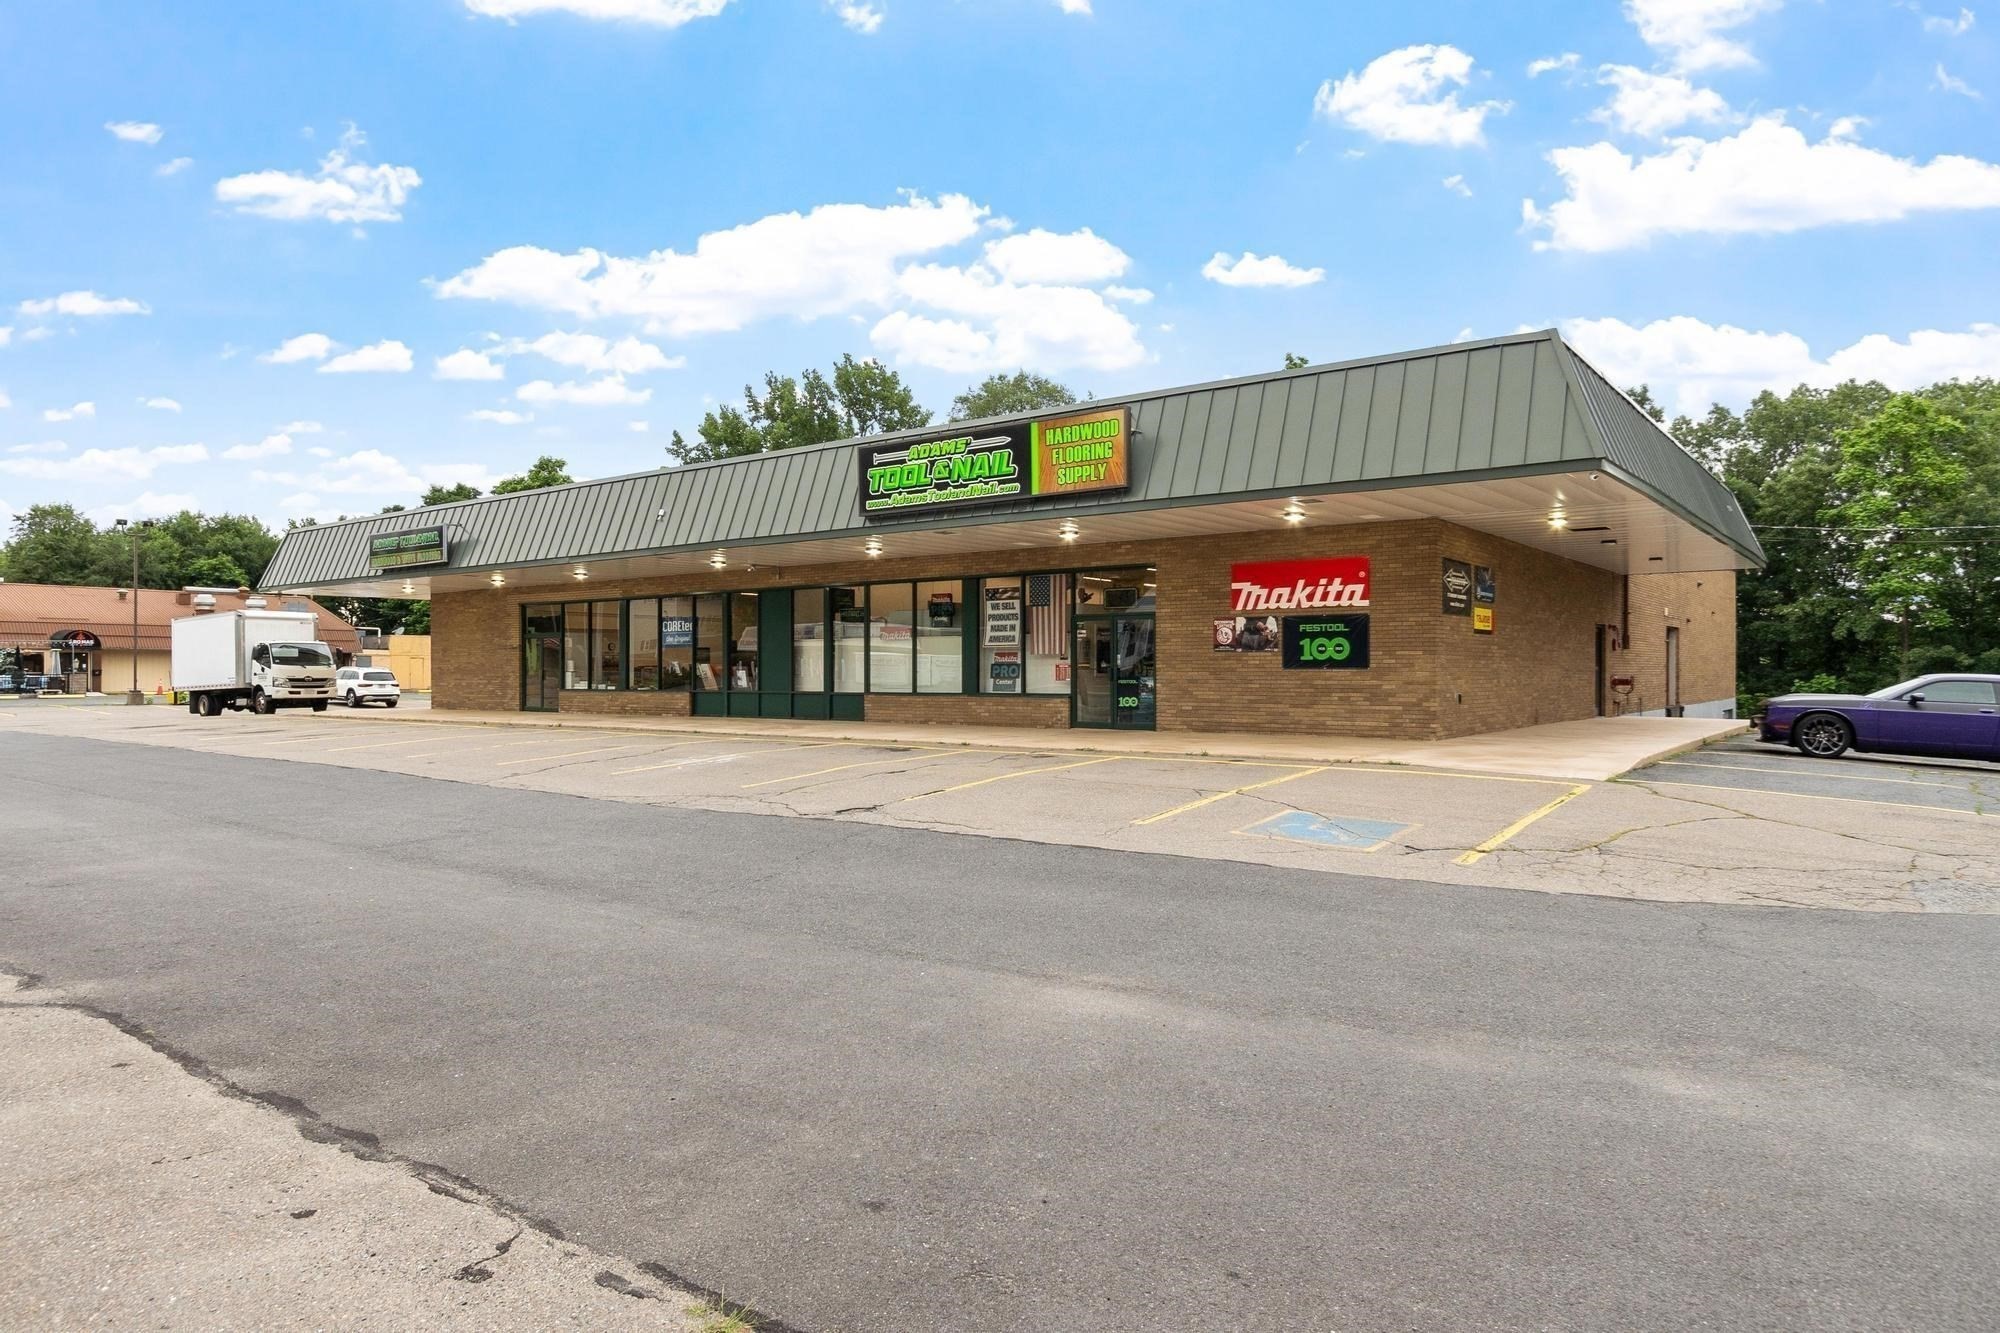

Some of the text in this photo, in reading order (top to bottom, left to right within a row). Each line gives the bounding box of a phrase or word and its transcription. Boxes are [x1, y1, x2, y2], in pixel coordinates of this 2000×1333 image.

[1046, 419, 1120, 446] HARDWOOD
[908, 437, 972, 461] ADAMS'
[1052, 441, 1113, 466] FLOORING
[1057, 462, 1108, 486] SUPPLY
[866, 483, 1020, 510] www.AdamsToolandNail.com
[1232, 578, 1370, 610] Makita
[991, 602, 1016, 610] WE SELL
[988, 613, 1019, 621] PRODUCTS
[990, 624, 1016, 632] MADE IN
[1299, 624, 1349, 632] FESTOOL
[988, 635, 1016, 643] AMERICA
[1299, 637, 1350, 661] 100
[992, 666, 1019, 677] PRO
[1118, 697, 1138, 707] 100
